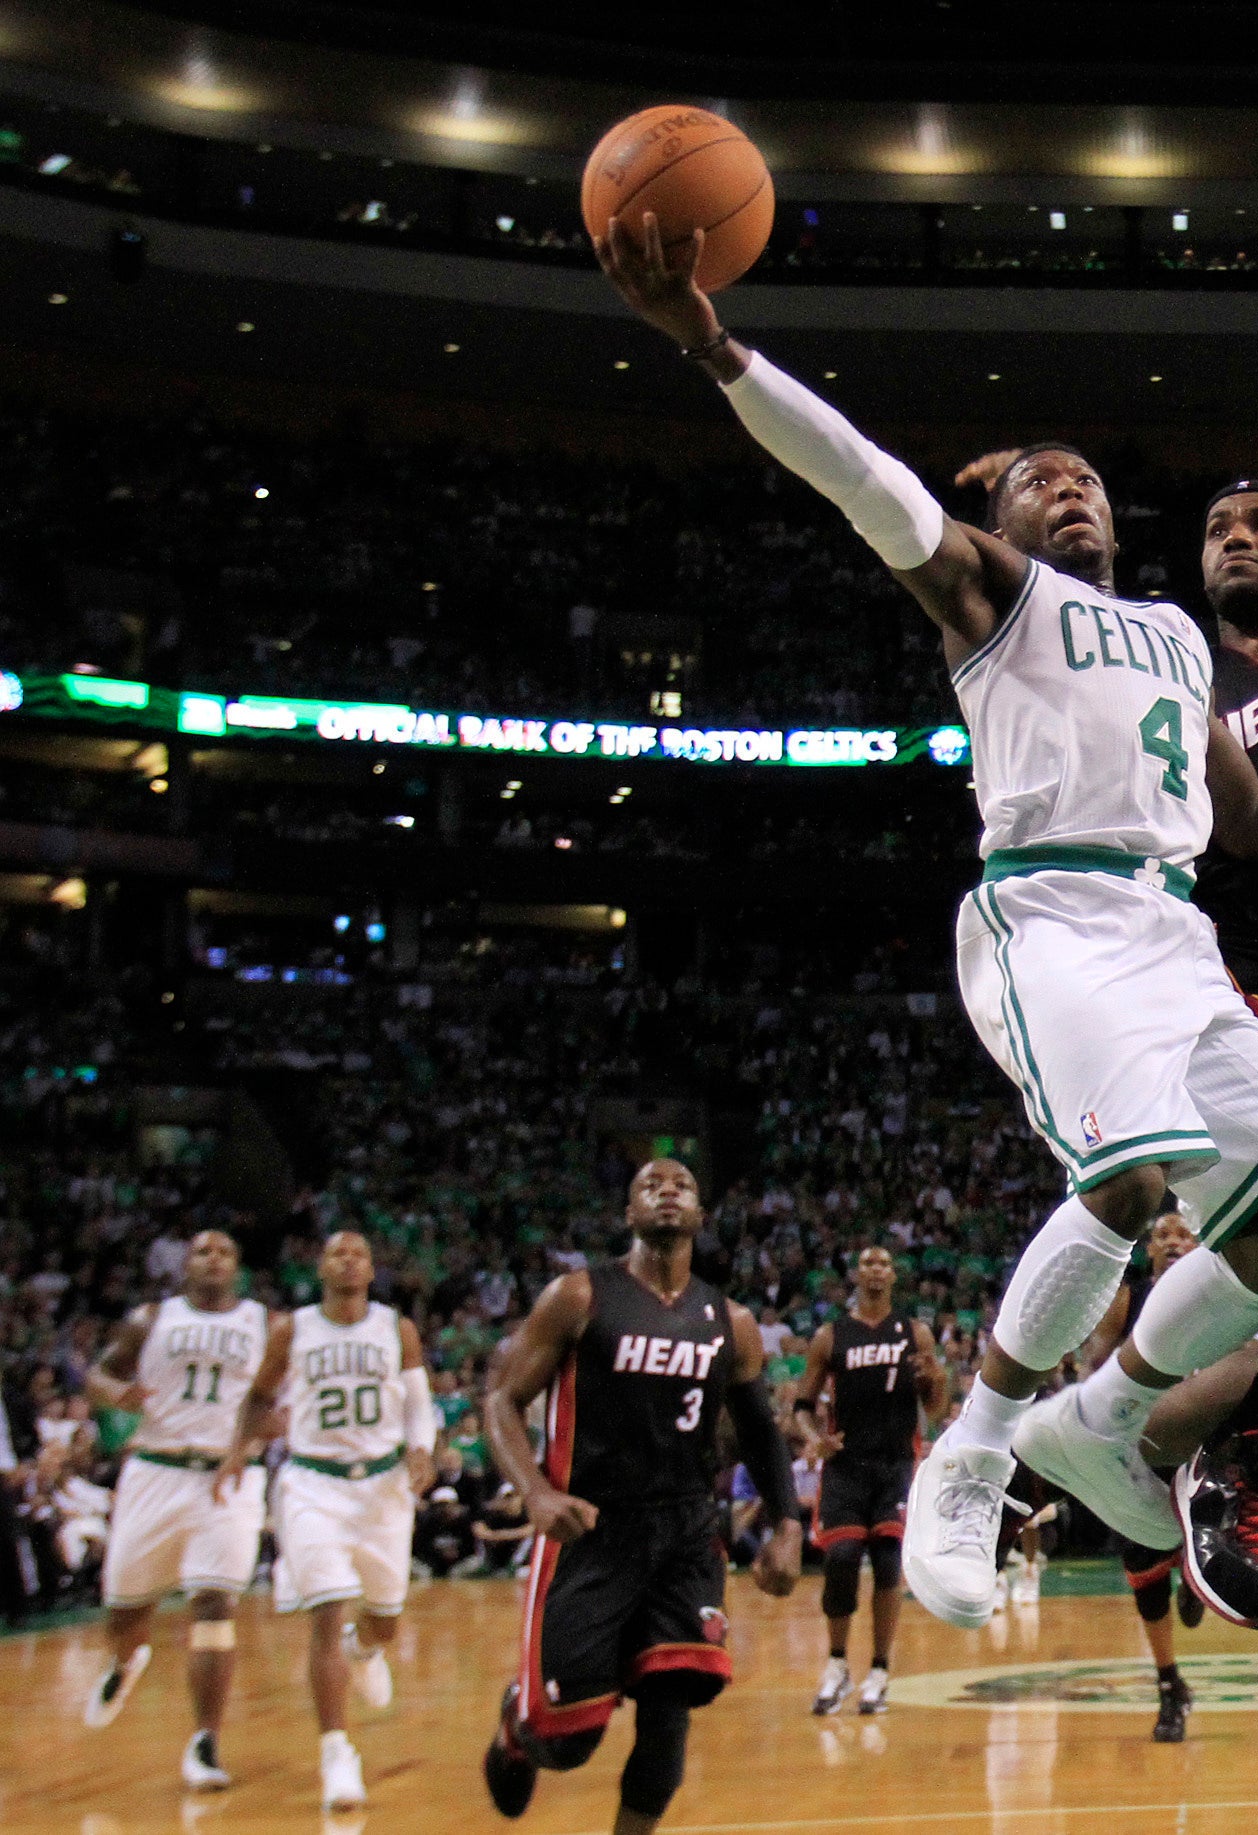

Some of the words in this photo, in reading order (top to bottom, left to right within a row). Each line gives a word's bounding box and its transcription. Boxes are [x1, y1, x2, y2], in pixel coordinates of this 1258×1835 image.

[317, 706, 456, 745] OFFICIAL
[457, 715, 548, 751] BANK
[550, 721, 595, 754] OF
[661, 727, 783, 761] BOSTON
[787, 730, 898, 761] CELTICS
[1138, 696, 1189, 801] 4
[166, 1325, 250, 1366] CELTICS
[306, 1341, 388, 1385] CELTICS
[614, 1334, 724, 1379] HEAT
[846, 1339, 908, 1369] HEAT
[182, 1360, 222, 1402] 11
[884, 1367, 898, 1392] 1
[318, 1383, 382, 1430] 20
[675, 1387, 704, 1432] 3
